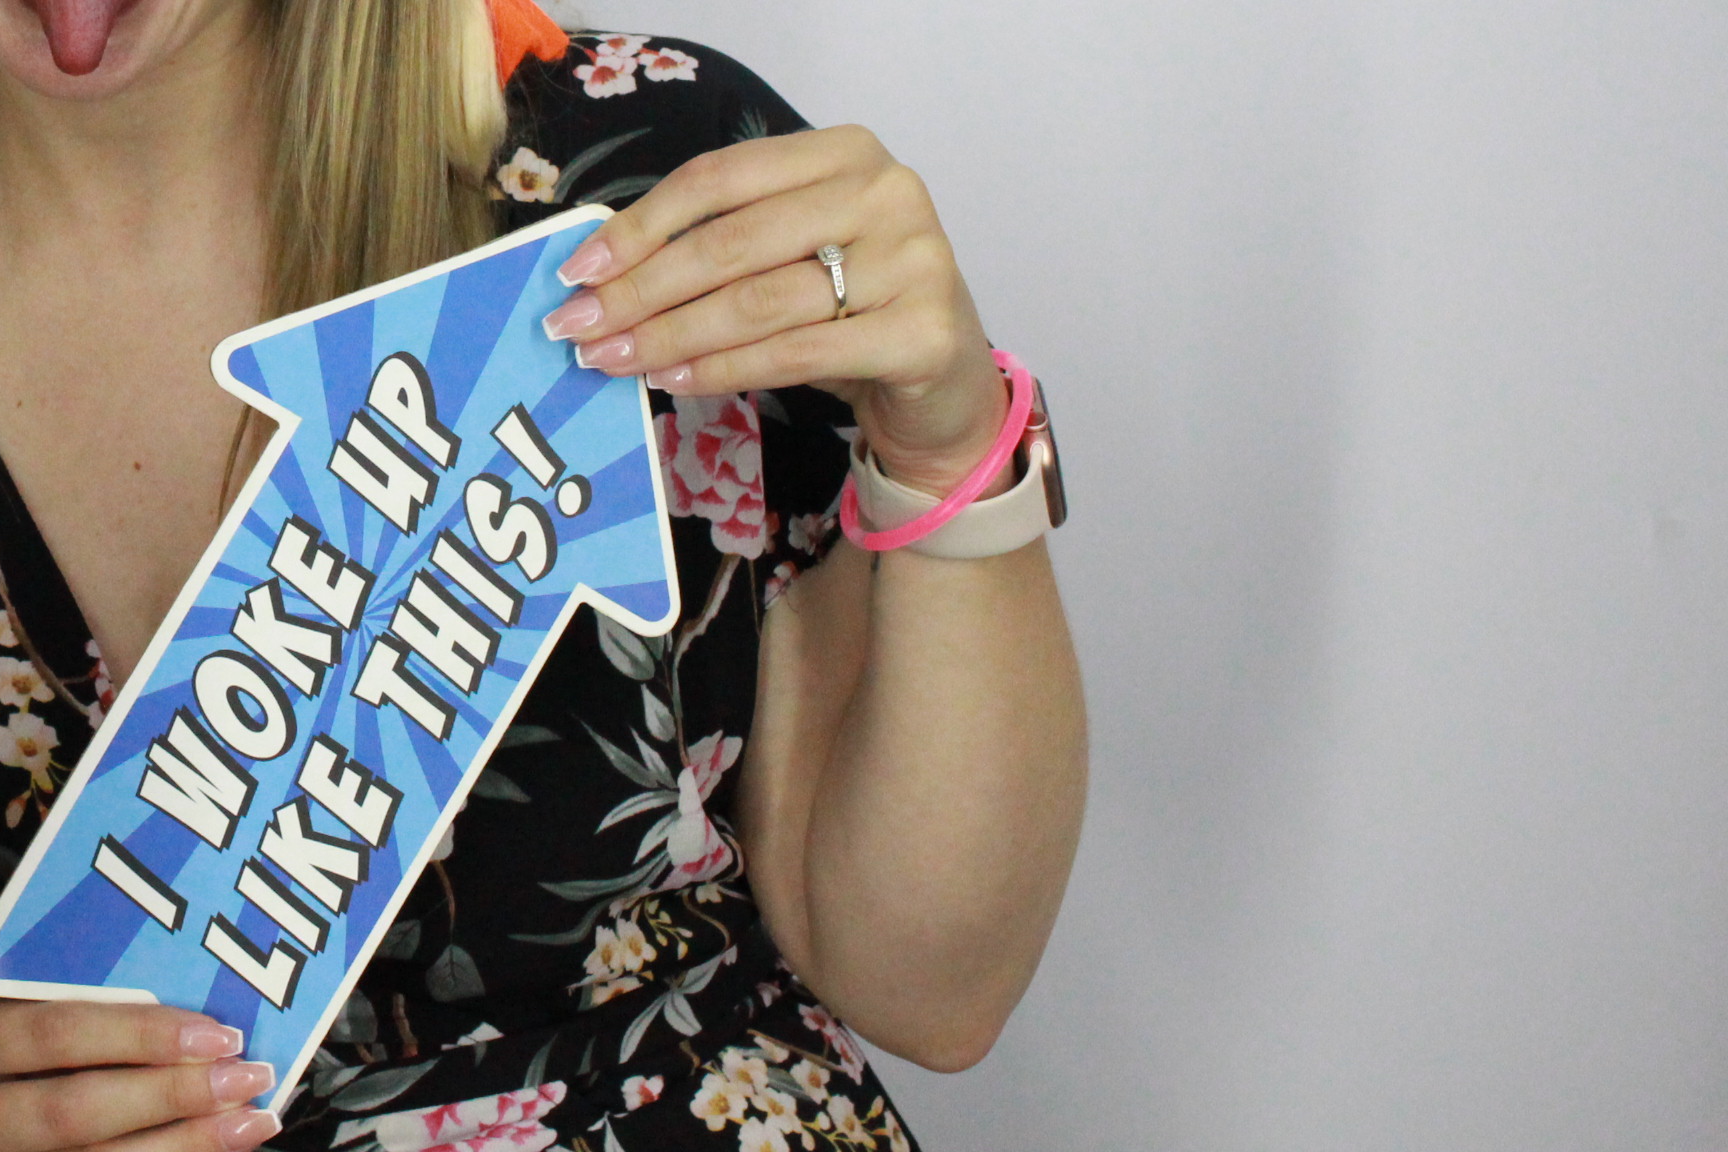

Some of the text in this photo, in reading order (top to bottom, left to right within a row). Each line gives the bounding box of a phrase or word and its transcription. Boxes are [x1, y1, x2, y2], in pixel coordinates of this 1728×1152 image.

[90, 350, 461, 934] I WOKE UP
[199, 400, 592, 1012] LIKE THIS!
